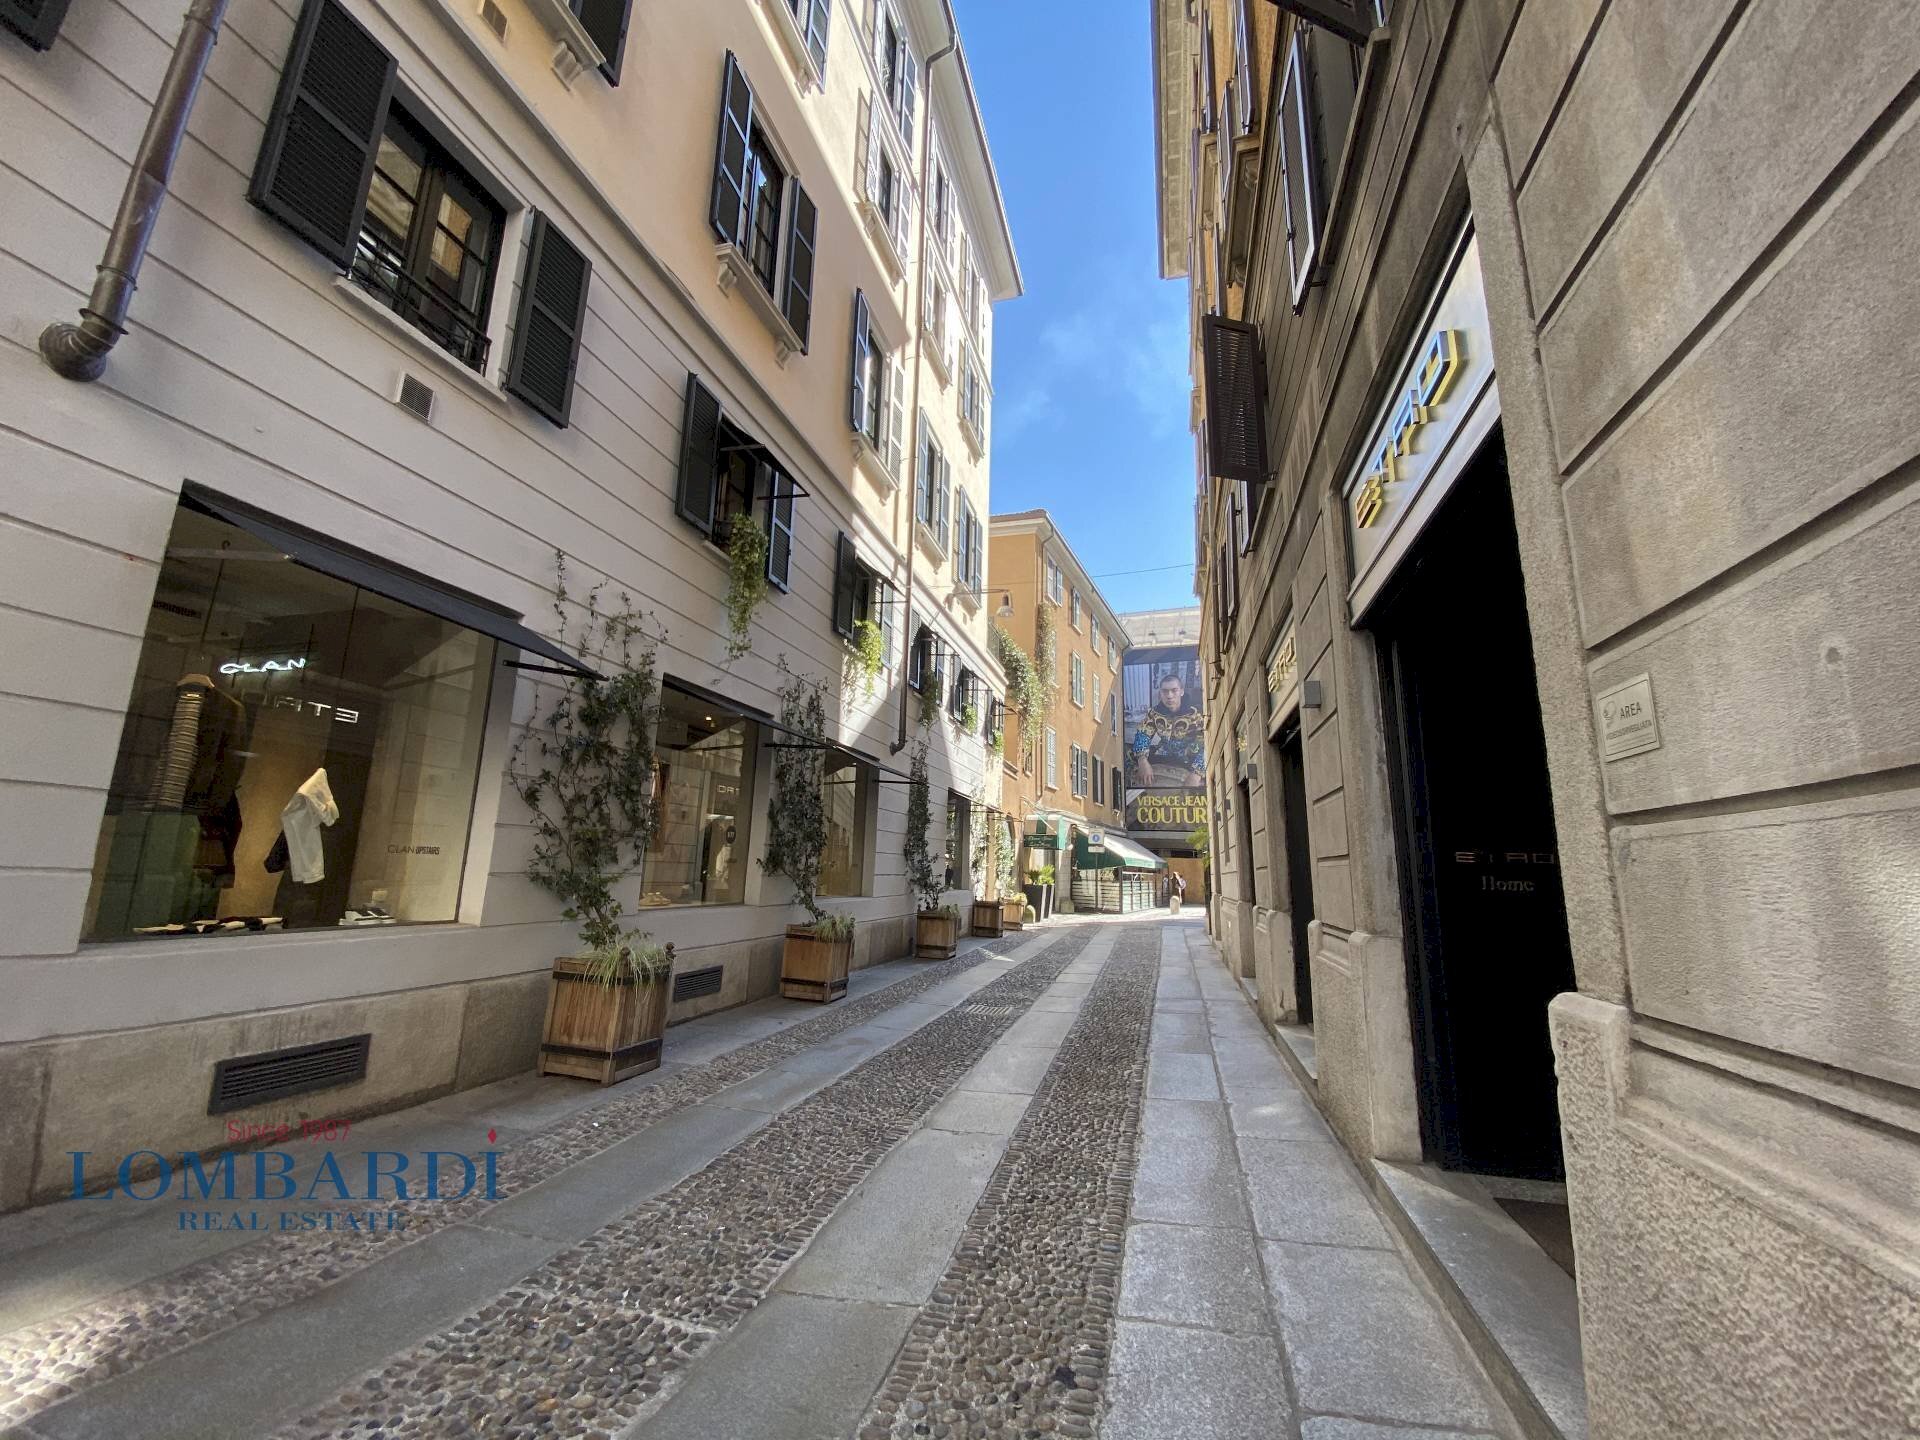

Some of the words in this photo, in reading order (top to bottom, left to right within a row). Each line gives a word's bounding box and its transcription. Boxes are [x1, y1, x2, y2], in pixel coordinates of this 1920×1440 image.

[220, 658, 306, 674] CLAN
[1620, 702, 1642, 719] AREA
[1137, 795, 1180, 807] VERSACE
[1181, 795, 1208, 807] JEAN
[1136, 807, 1208, 824] COUTUR
[1481, 875, 1535, 891] Home
